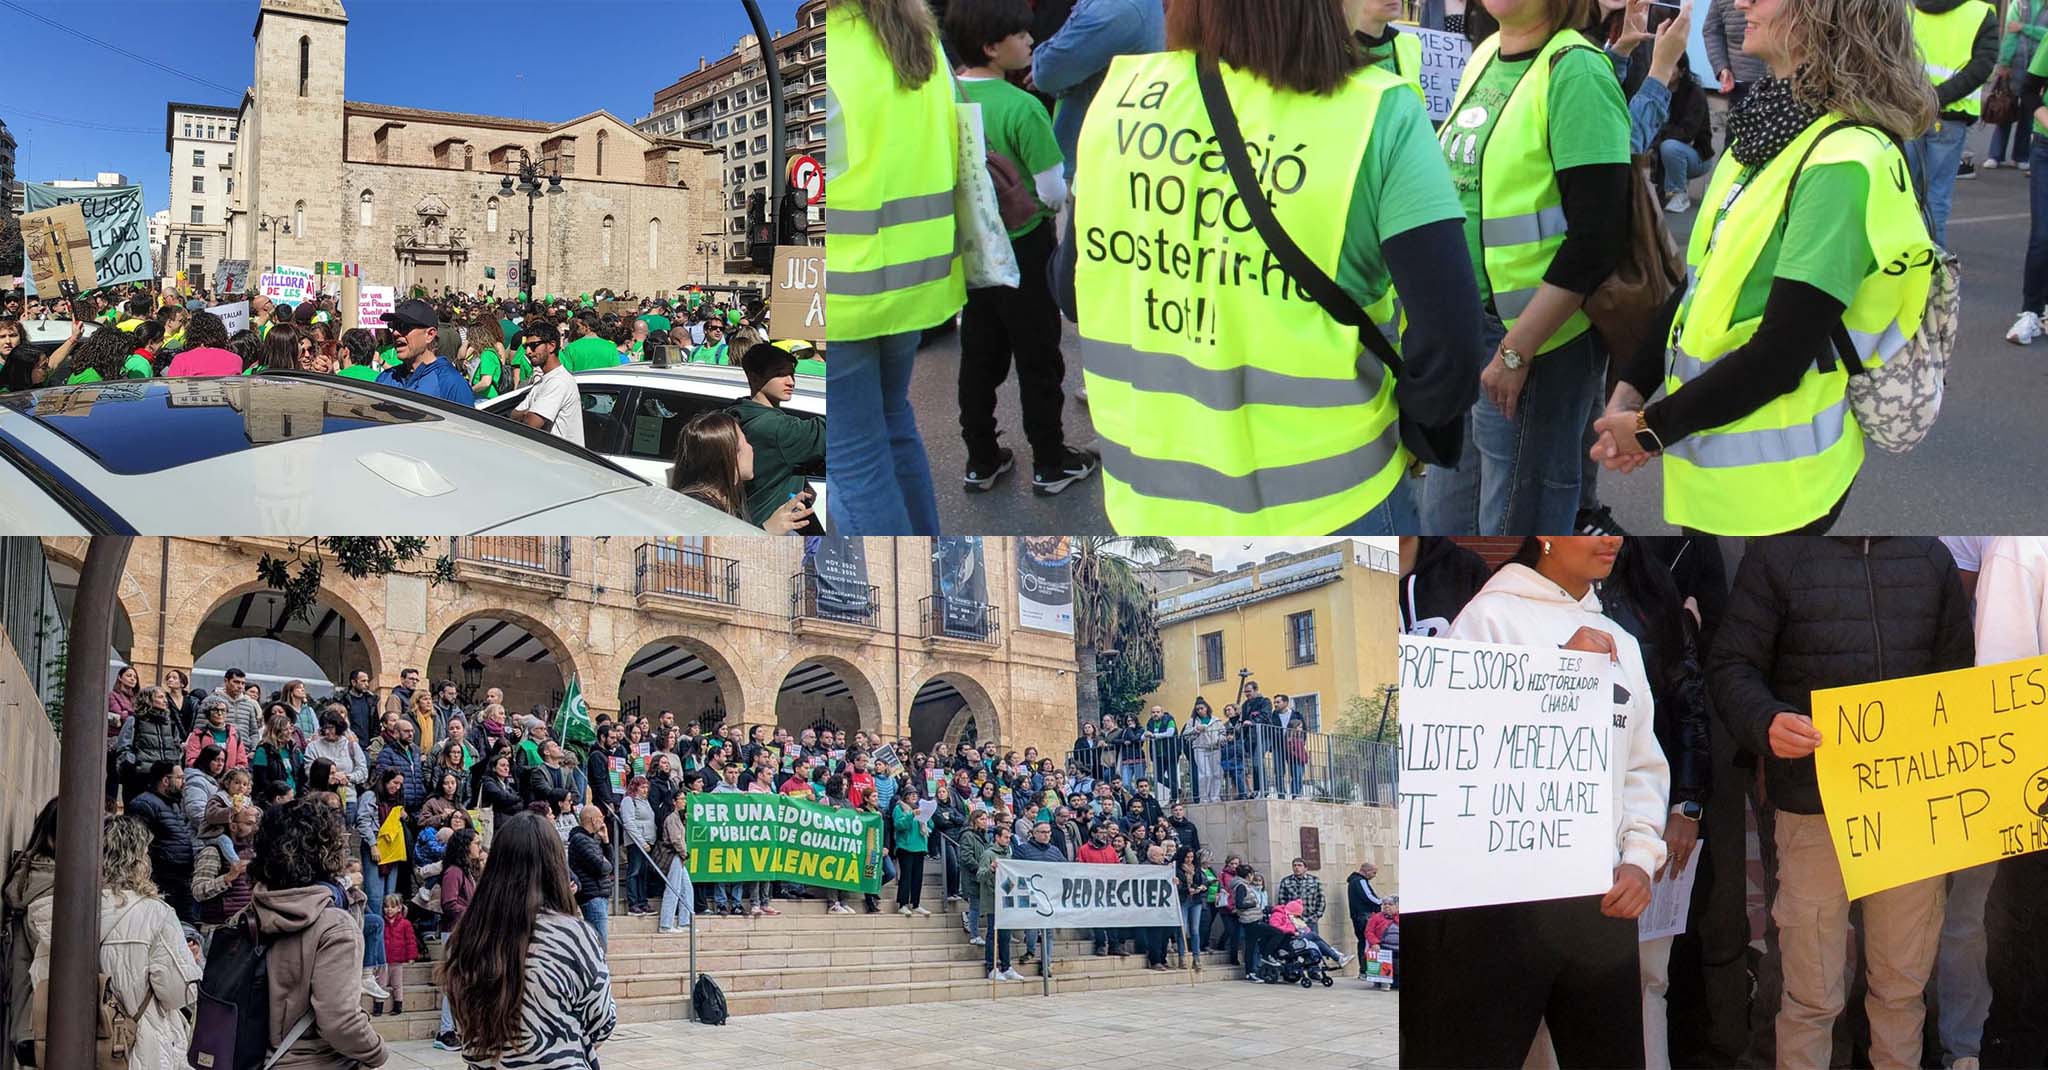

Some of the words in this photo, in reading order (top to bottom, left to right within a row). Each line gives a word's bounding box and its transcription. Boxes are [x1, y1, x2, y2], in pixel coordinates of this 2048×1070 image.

[1116, 73, 1169, 110] La
[1130, 171, 1186, 216] no
[1145, 287, 1216, 346] tot!!
[1557, 656, 1583, 673] IES
[1527, 673, 1600, 691] HISTORIADOR
[1541, 691, 1580, 713] CHABÀS
[1838, 700, 1885, 745] NO
[1933, 690, 1948, 727] A
[1991, 668, 2047, 714] LES
[1493, 724, 1608, 772] MEREIXEN
[1852, 732, 2017, 793] RETALLADES
[1457, 785, 1478, 817] I
[1492, 781, 1525, 816] UN
[1536, 780, 1600, 814] SALARI
[693, 803, 729, 822] PER
[735, 803, 777, 822] UNA
[778, 804, 863, 836] EDUCACIÓ
[1488, 819, 1574, 852] DIGNE
[1846, 811, 1881, 857] EN
[1927, 788, 1991, 845] FP
[710, 822, 772, 842] PÚBLICA
[780, 826, 798, 844] DE
[800, 831, 863, 855] QUALITAT
[1999, 823, 2024, 856] IES
[689, 848, 699, 873] I
[708, 848, 743, 873] EN
[1062, 877, 1172, 908] PEDREGUER
